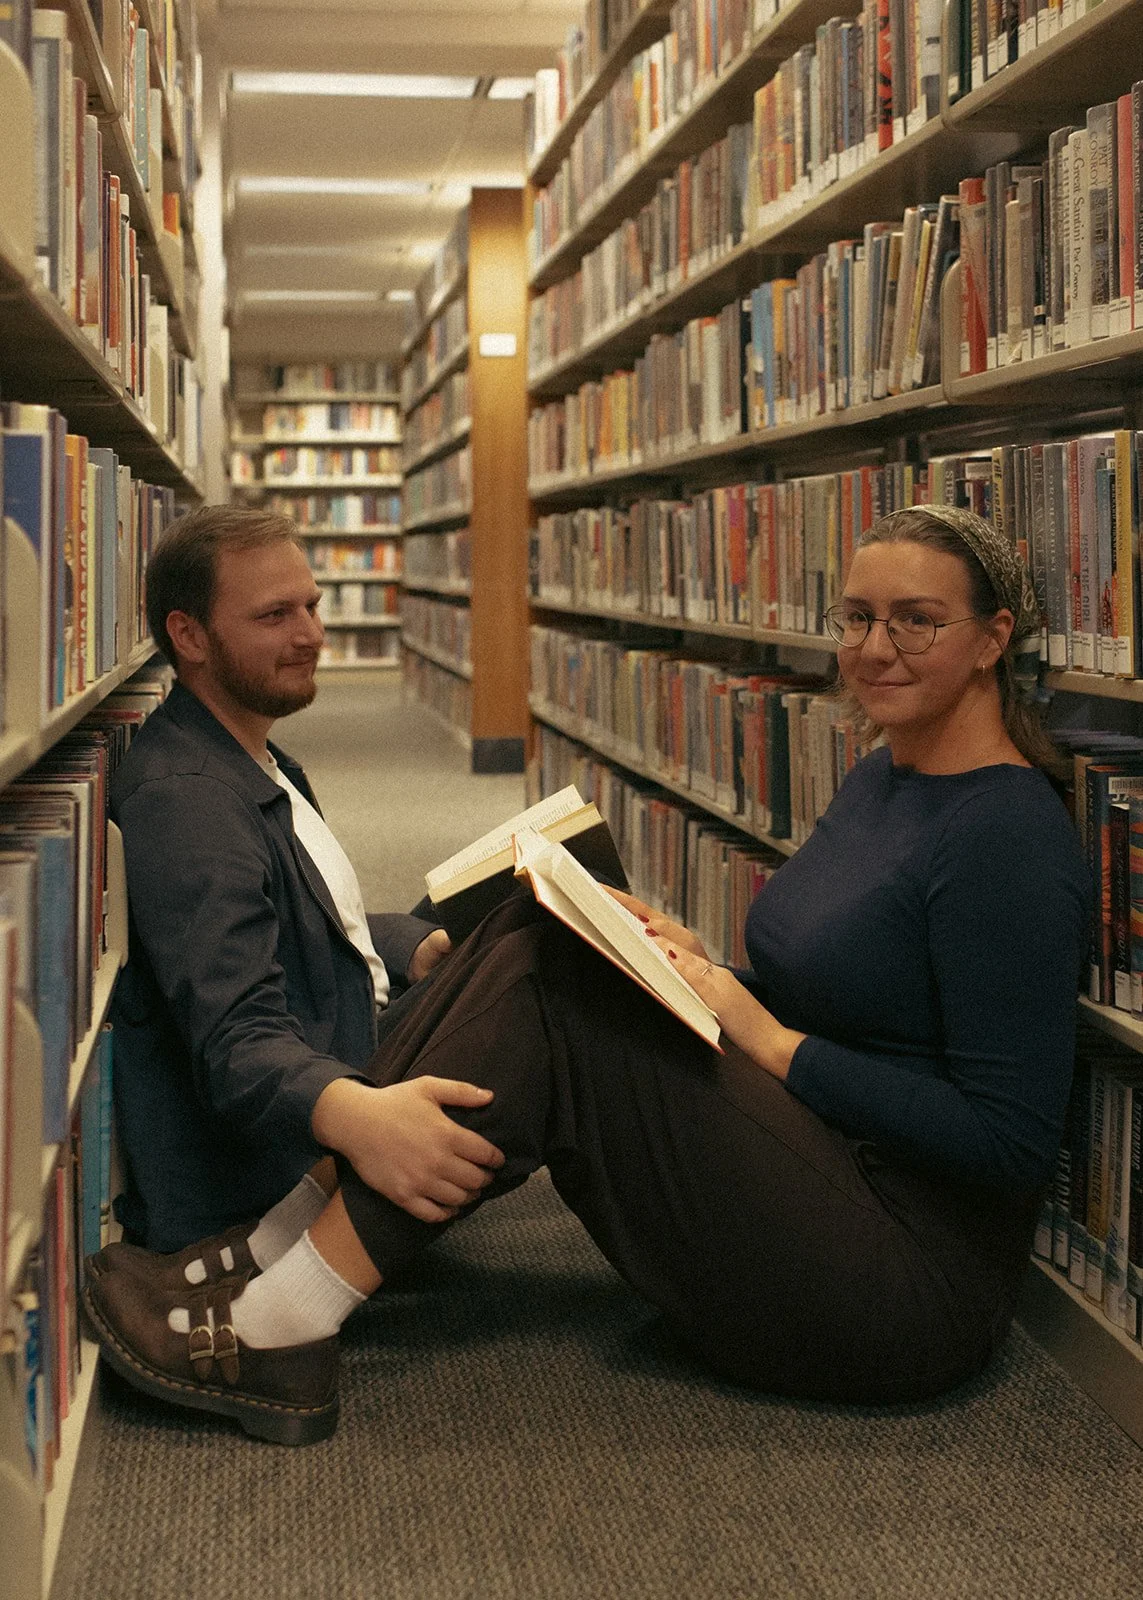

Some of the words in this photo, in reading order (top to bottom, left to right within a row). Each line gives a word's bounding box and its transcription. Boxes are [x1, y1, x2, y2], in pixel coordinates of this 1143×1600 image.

[1072, 157, 1085, 193] Great
[1089, 131, 1098, 187] CONROY
[1098, 145, 1108, 168] PAT
[1073, 196, 1085, 242] Santini
[1073, 247, 1082, 262] Pat
[1072, 263, 1082, 301] Conroy
[993, 458, 1002, 479] THE
[1033, 457, 1043, 481] THE
[945, 470, 955, 506] STEP
[994, 483, 1004, 534] MARAUDE
[1034, 493, 1044, 555] SAVAGE
[1048, 474, 1056, 574] ORCHARDIST
[1081, 533, 1089, 563] KISS
[1036, 565, 1046, 611] KIND
[1081, 566, 1090, 592] THE
[1082, 596, 1091, 624] GIRL
[1117, 922, 1126, 960] ROOM
[1093, 1078, 1105, 1146] CATHERINE
[1091, 1149, 1103, 1206] COULTER
